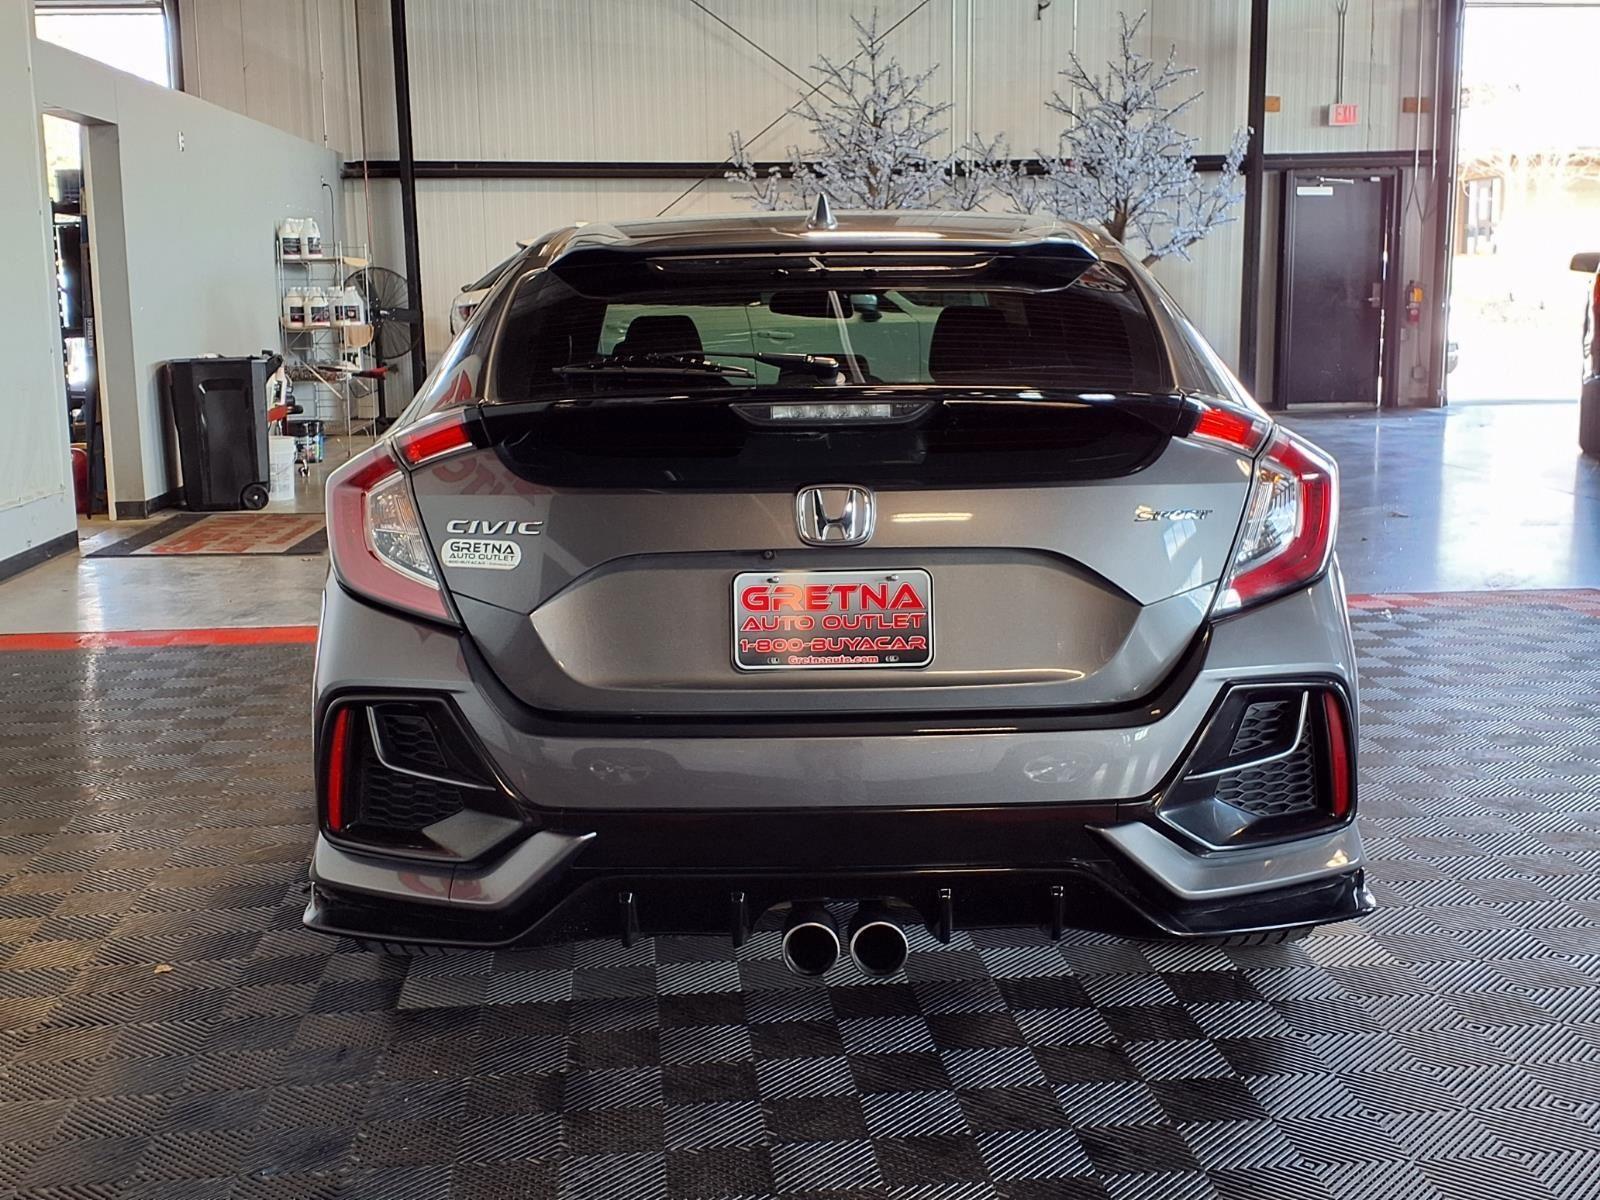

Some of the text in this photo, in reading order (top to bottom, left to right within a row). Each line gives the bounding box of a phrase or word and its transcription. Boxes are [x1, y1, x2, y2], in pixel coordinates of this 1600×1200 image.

[446, 520, 543, 535] CIVIC
[450, 541, 515, 555] GRETNA
[478, 553, 516, 562] OUTLET
[741, 583, 926, 612] GRETNA
[740, 613, 927, 632] AUTO OUTLET
[740, 636, 927, 653] 1-800-BUYACAR
[787, 655, 879, 665] Gretnaauto.com
